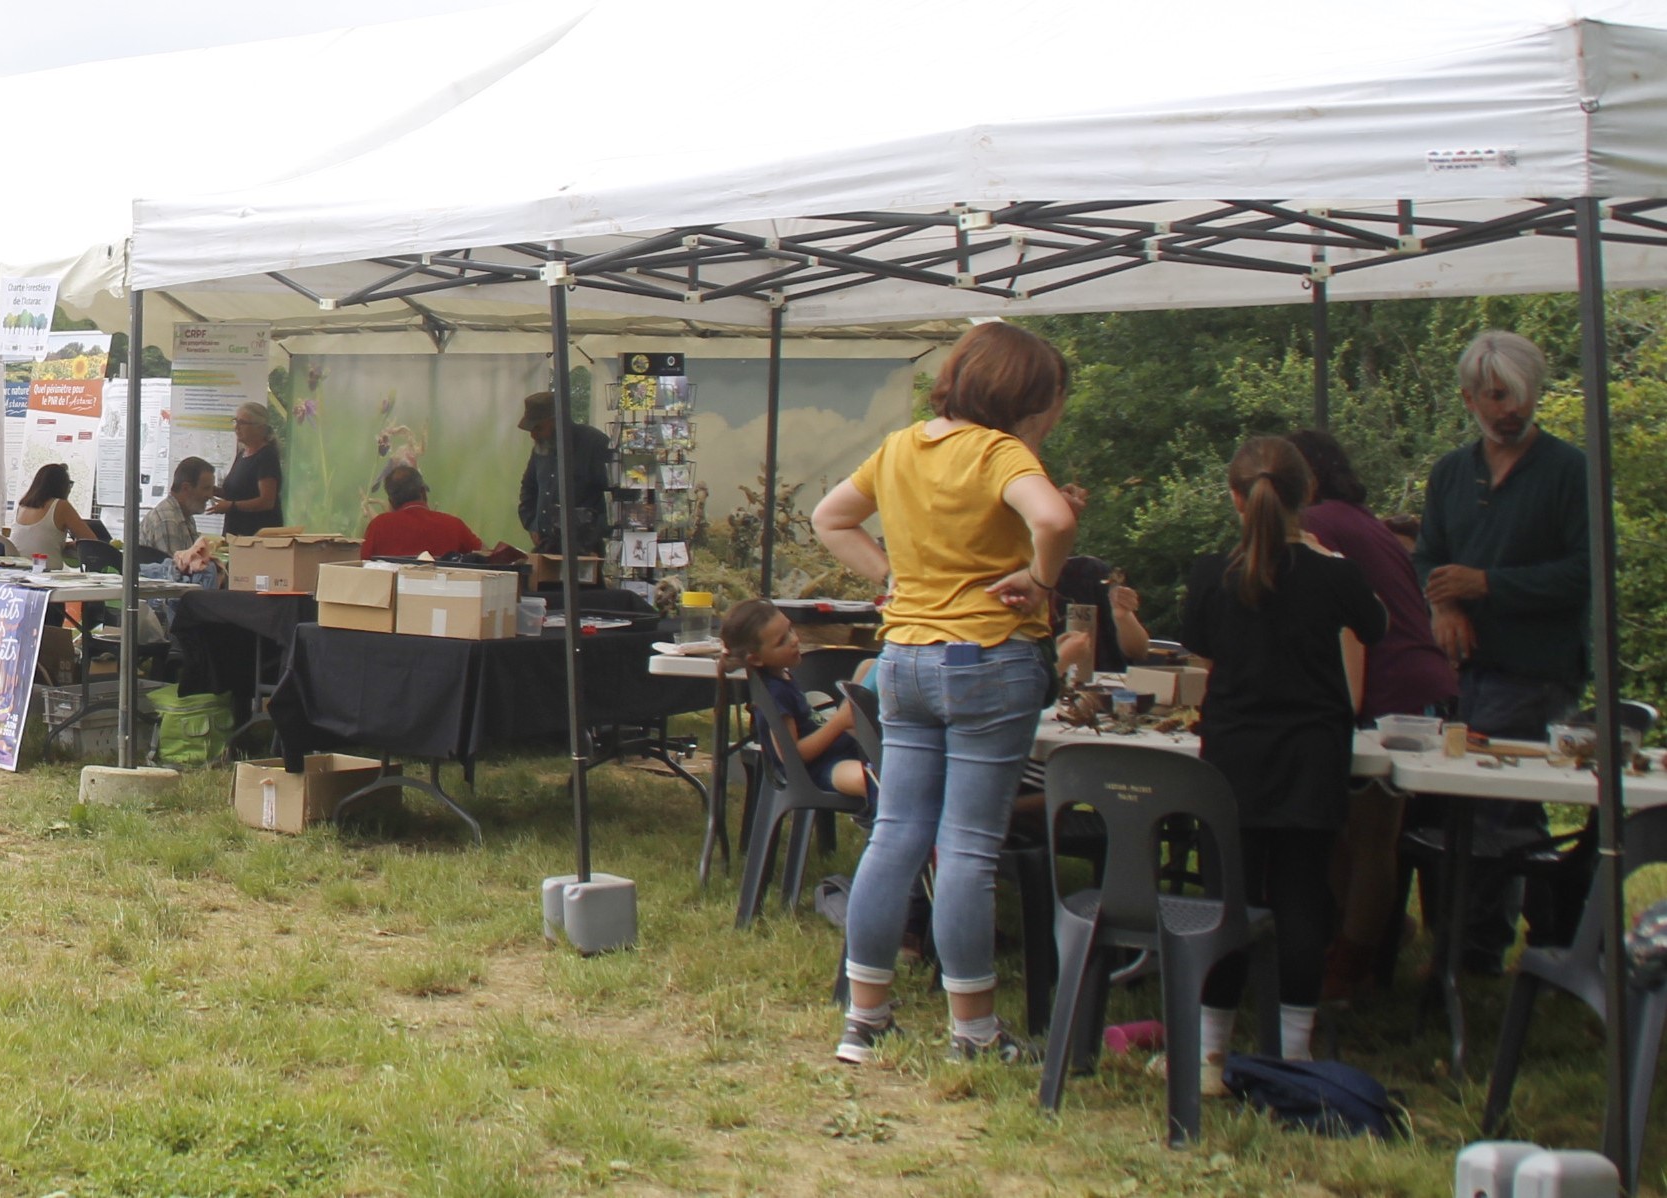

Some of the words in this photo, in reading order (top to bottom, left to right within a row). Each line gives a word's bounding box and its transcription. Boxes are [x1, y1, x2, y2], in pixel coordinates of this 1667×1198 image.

[13, 297, 20, 305] de
[184, 329, 207, 338] CRPF
[228, 344, 249, 354] Gers
[34, 383, 46, 395] Quel
[46, 383, 72, 396] périmètre
[72, 385, 85, 396] pour
[42, 395, 48, 406] le
[59, 396, 65, 406] de
